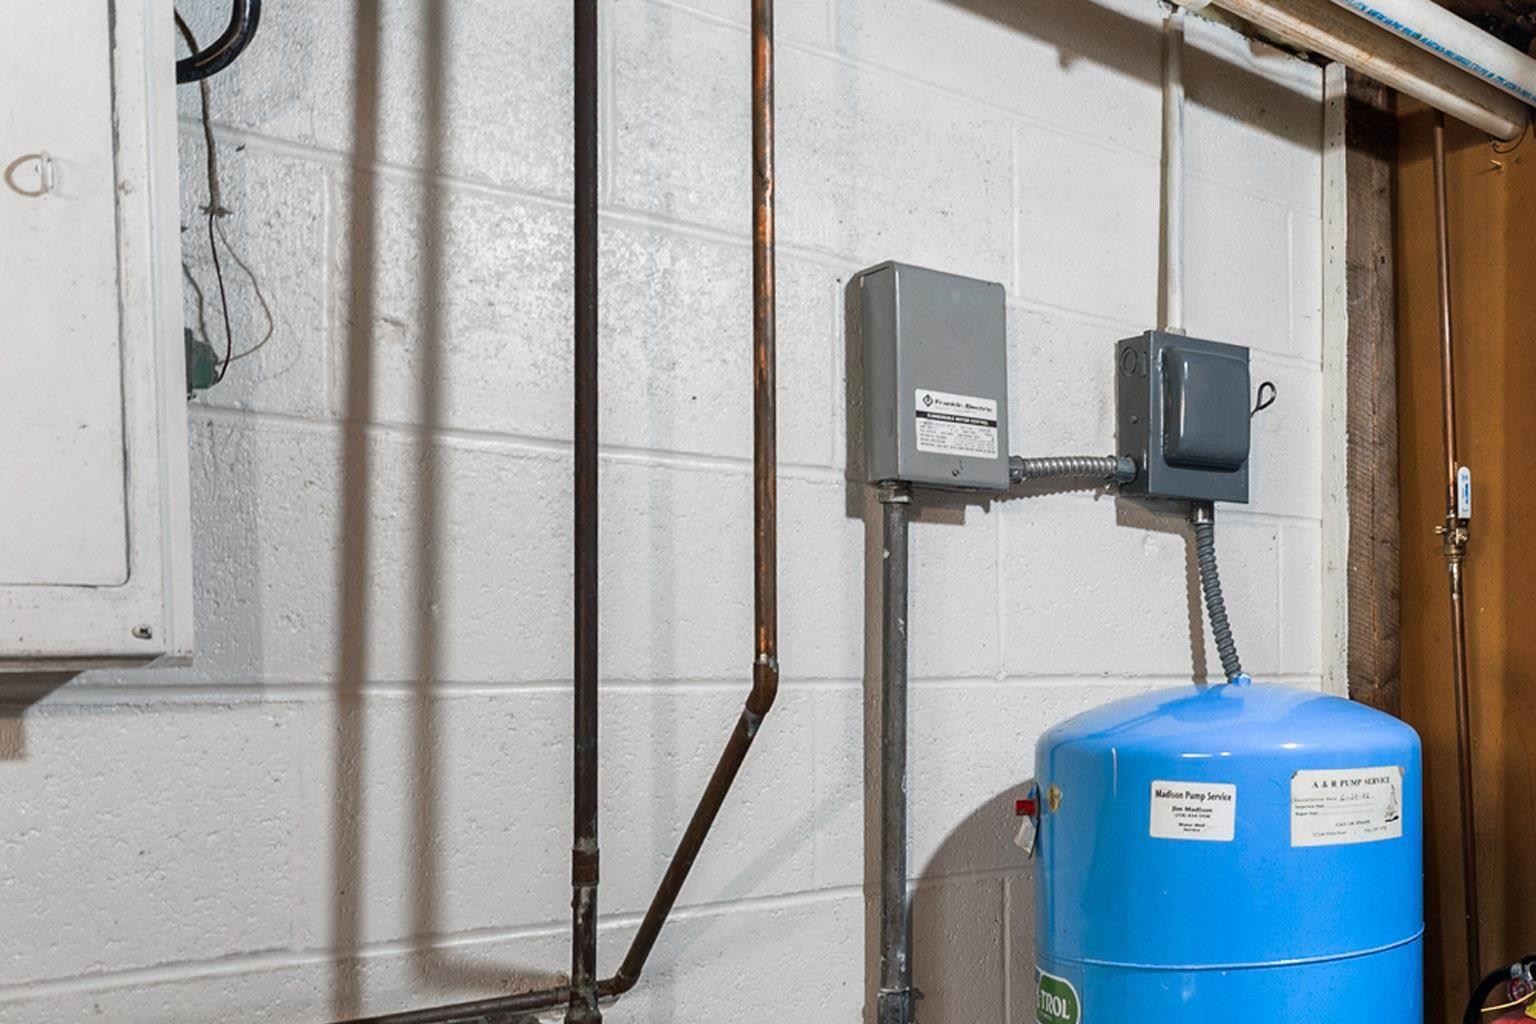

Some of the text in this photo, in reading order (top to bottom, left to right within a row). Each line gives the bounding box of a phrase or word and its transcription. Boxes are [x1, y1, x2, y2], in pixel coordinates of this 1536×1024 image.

[1312, 781, 1319, 789] A
[1322, 780, 1328, 788] &
[1340, 778, 1362, 787] PUMP
[1155, 789, 1233, 803] Madison Pump Service
[1038, 986, 1071, 1020] TROL
